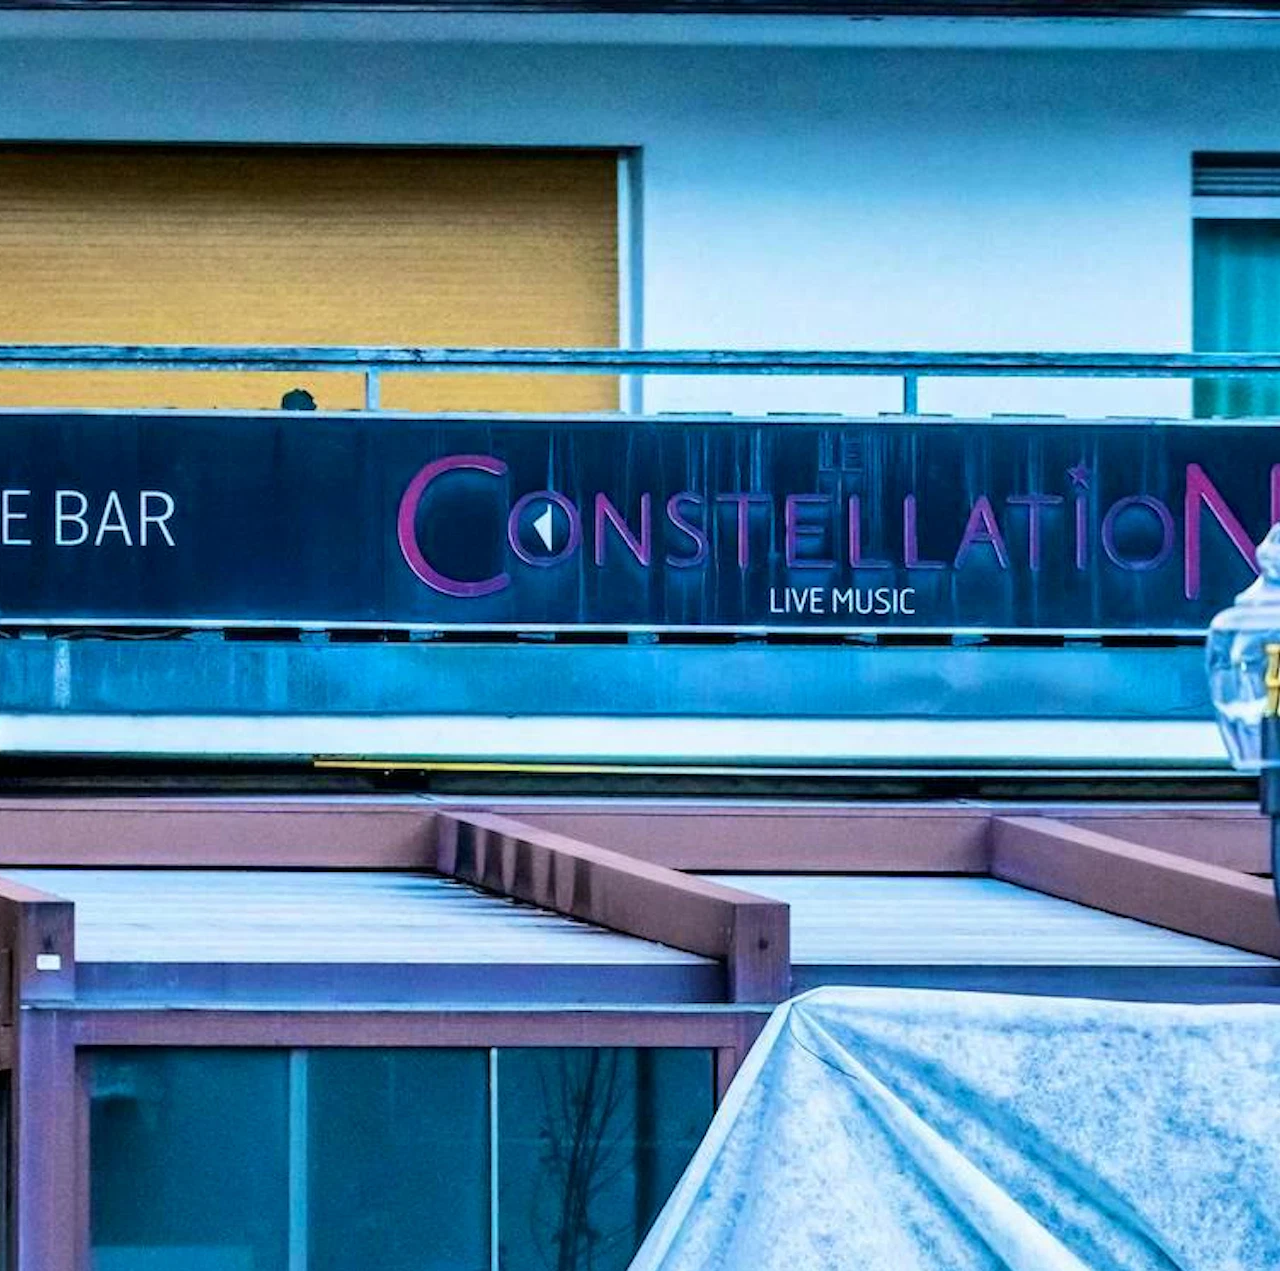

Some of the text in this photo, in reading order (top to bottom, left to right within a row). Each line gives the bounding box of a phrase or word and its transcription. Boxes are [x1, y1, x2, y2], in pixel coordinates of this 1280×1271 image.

[55, 489, 176, 546] BAR
[770, 586, 917, 615] LIVE MUSIC
